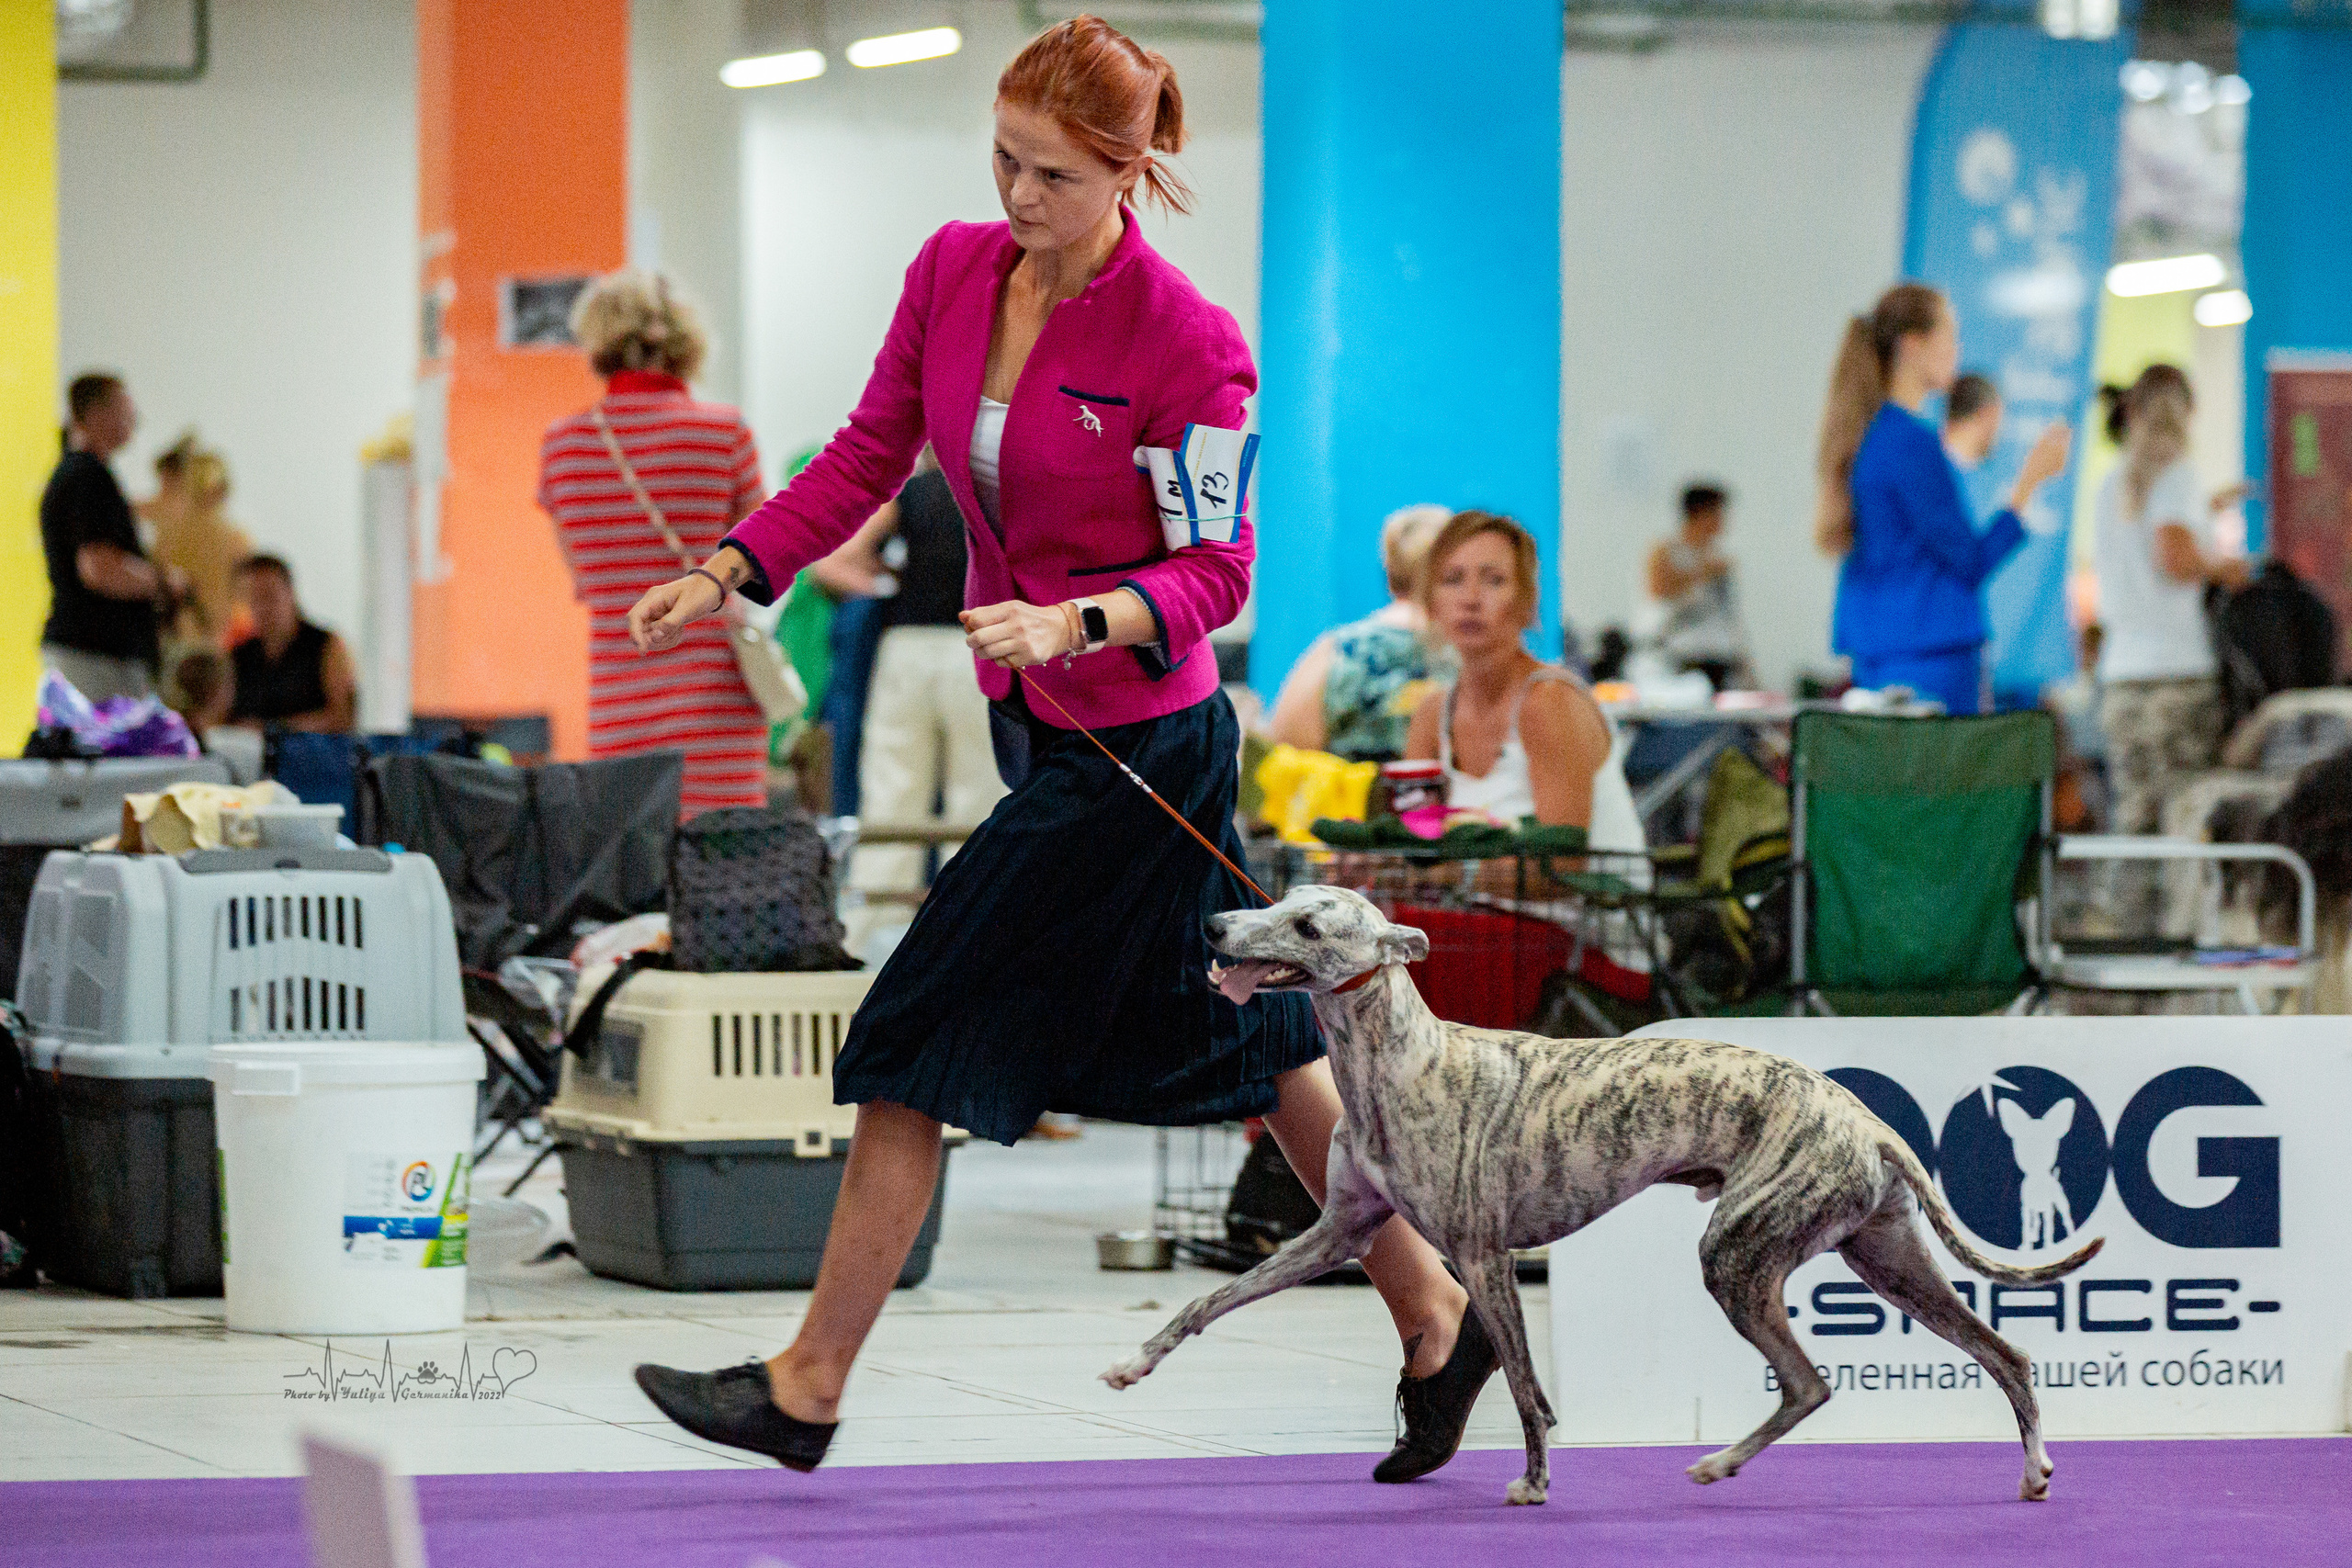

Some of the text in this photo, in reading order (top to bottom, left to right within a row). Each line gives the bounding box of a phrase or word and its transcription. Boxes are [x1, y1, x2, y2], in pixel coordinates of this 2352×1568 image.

[1200, 471, 1229, 509] 13
[1765, 1348, 2285, 1391] веленная ашей собаки
